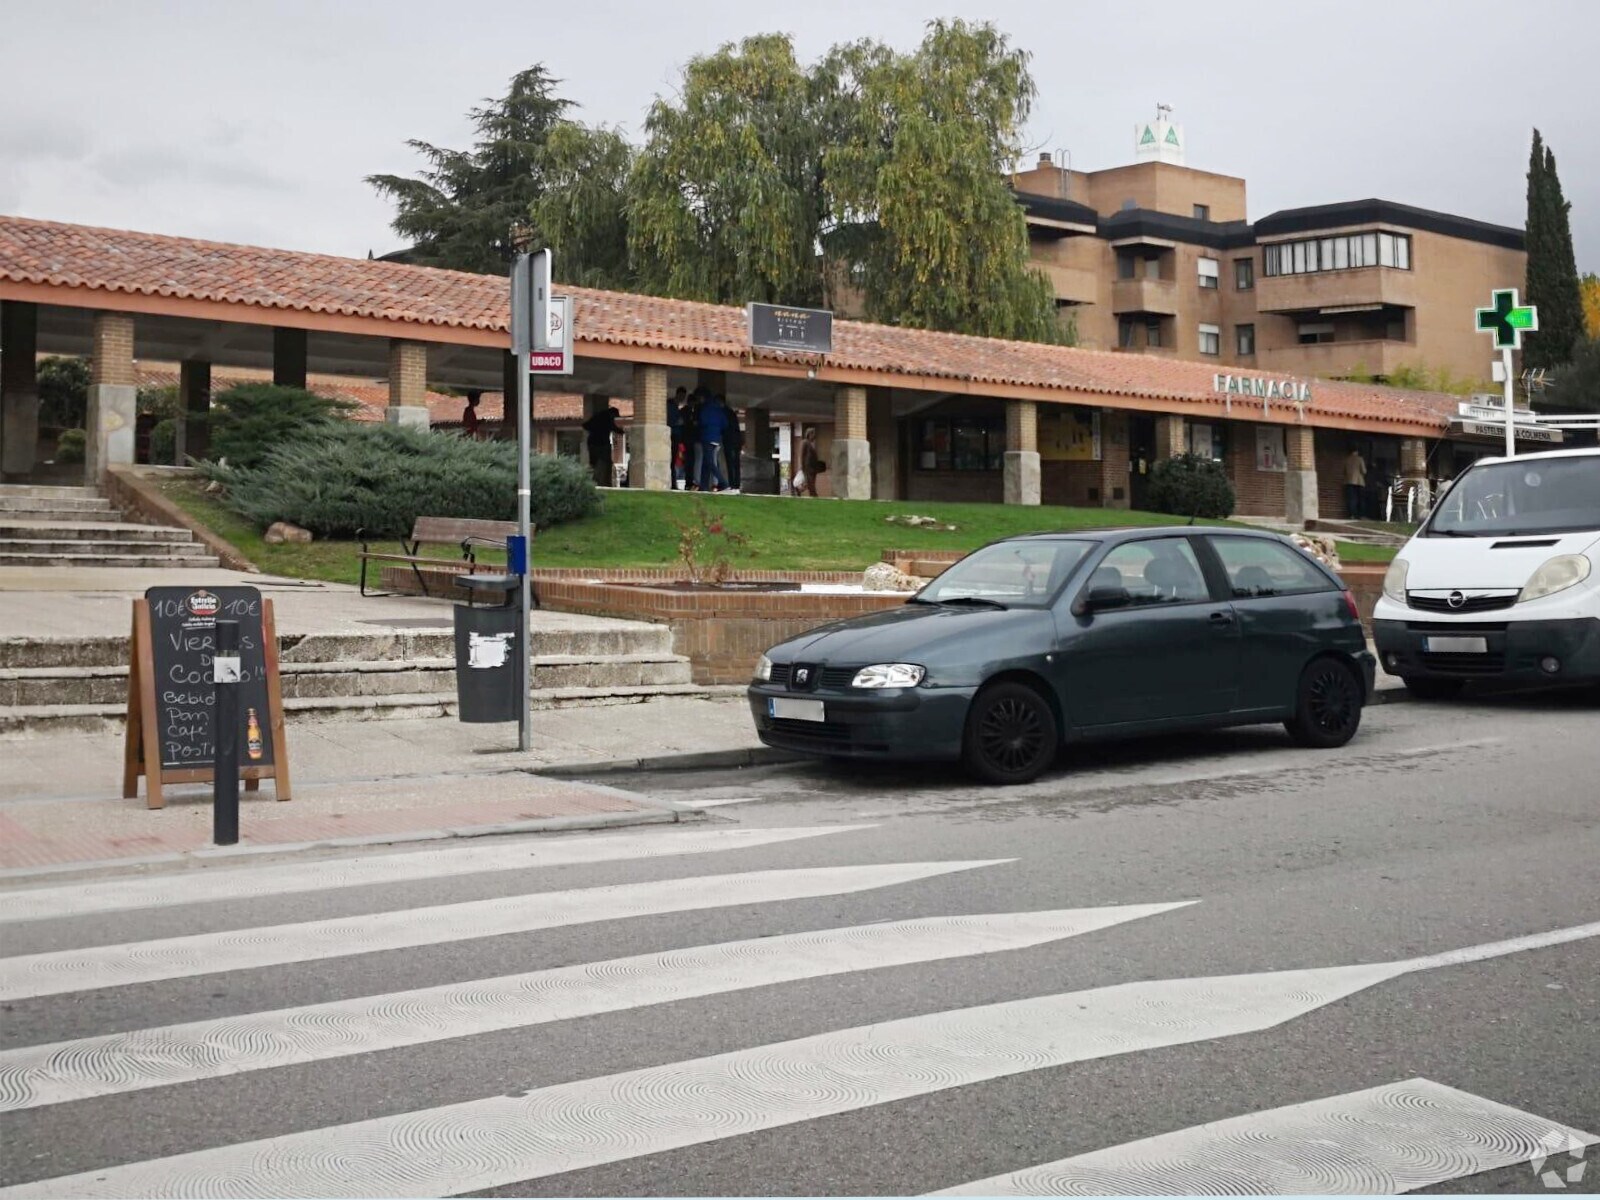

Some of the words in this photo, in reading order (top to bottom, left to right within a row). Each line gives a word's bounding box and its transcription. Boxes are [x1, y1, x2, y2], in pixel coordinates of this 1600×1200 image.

[532, 356, 562, 367] UDACO
[1213, 373, 1313, 401] FARMACIA
[1475, 424, 1505, 437] PASTELER
[154, 600, 187, 618] 10€
[224, 599, 260, 617] 10€
[163, 690, 216, 706] Bebid
